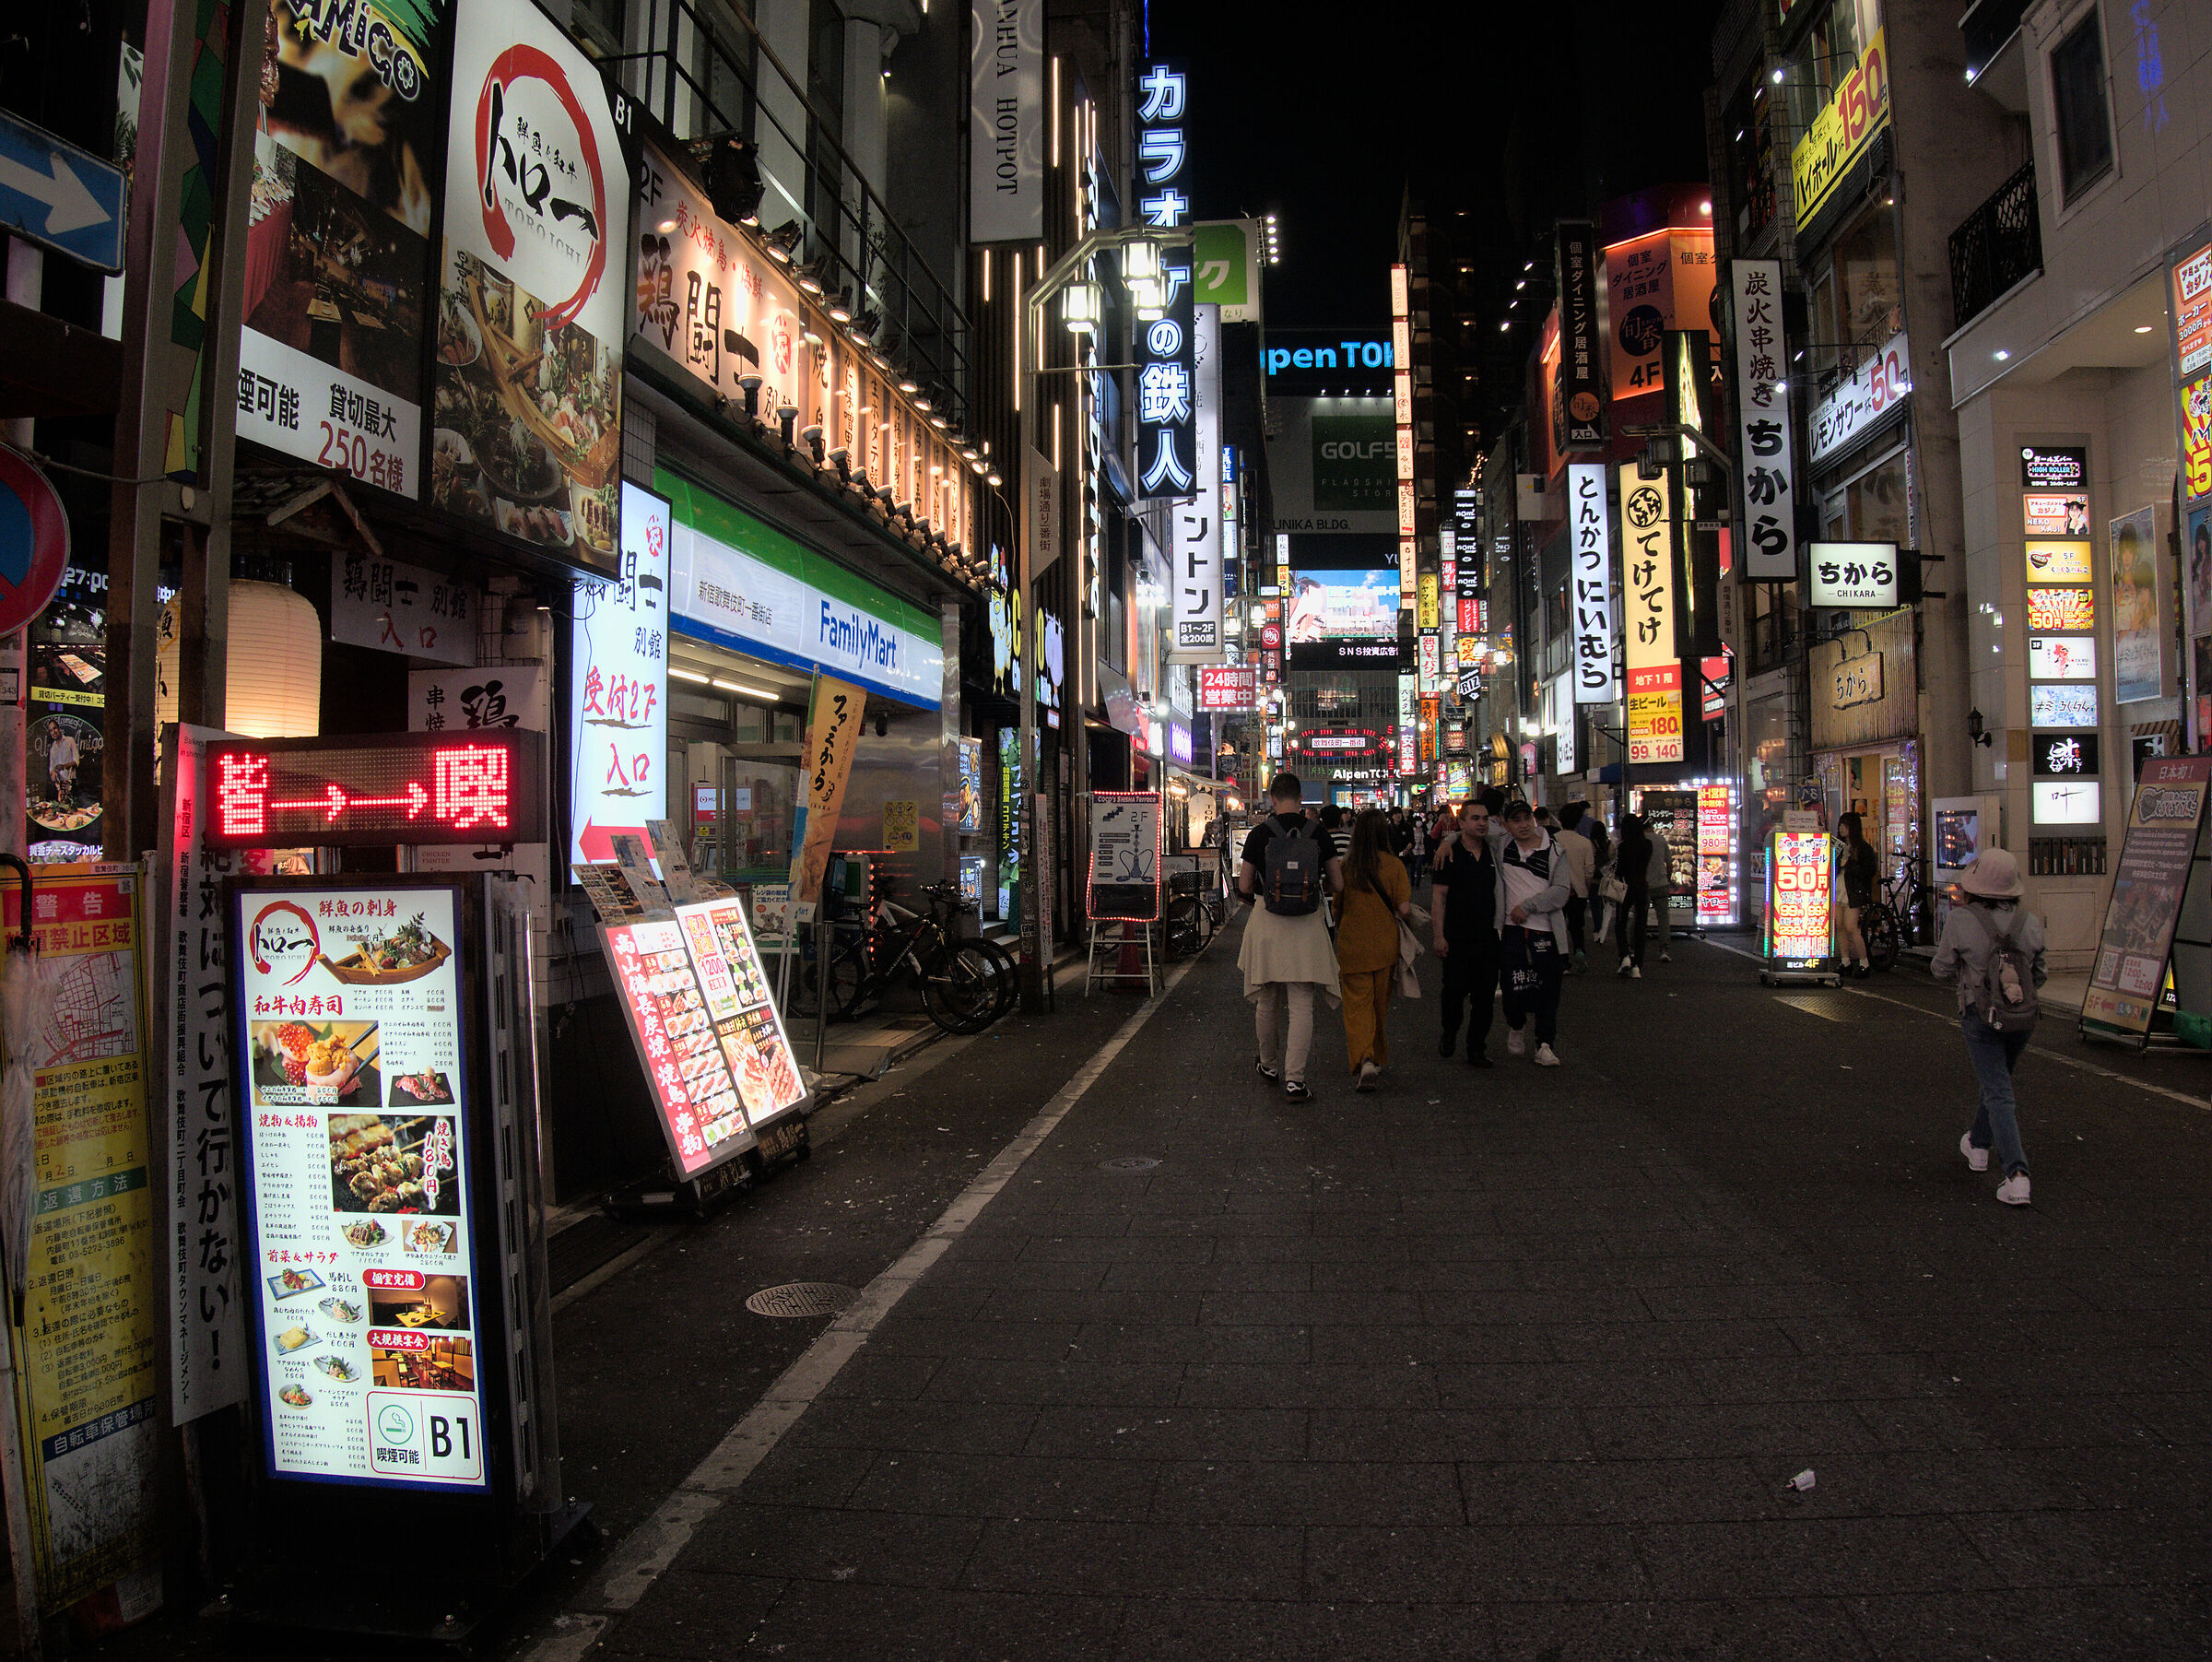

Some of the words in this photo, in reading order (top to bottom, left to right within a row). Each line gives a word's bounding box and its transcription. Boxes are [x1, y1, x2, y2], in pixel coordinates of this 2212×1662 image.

[615, 94, 632, 136] B1
[1796, 136, 1838, 213] ハイボール
[1838, 47, 1888, 152] 150円
[996, 96, 1018, 195] HOTPOT
[504, 196, 546, 245] TORO
[550, 231, 582, 266] ICHI
[1627, 250, 1653, 266] 個室
[1612, 260, 1669, 289] ダイニング
[1622, 279, 1661, 301] 居酒屋
[1568, 241, 1590, 380] 個室ダイニング居酒屋
[1744, 271, 1780, 407] 炭火串焼き
[1629, 360, 1661, 389] 4F
[330, 382, 397, 444] 貸切最大
[1574, 428, 1594, 440] 入口
[1810, 398, 1864, 458] レモンサワー
[318, 419, 404, 493] 250名様
[1747, 418, 1789, 556] ちから
[1039, 477, 1052, 551] 劇場通り一番街
[1273, 519, 1314, 530] UNIKA
[1316, 519, 1351, 531] BLDG.
[1578, 476, 1601, 572] とんかつ
[2027, 518, 2050, 526] NEKO
[2041, 525, 2061, 534] KAJI
[586, 550, 664, 612] 闘士
[1818, 560, 1894, 586] ちから
[1633, 531, 1665, 645] てけてけ
[1836, 589, 1877, 598] CHIKARA
[431, 584, 469, 619] 別館
[698, 581, 773, 628] 新宿歌舞伎町一番街店
[381, 611, 438, 651] 入口
[1577, 577, 1608, 690] にいむら
[2030, 611, 2063, 630] 50円
[633, 627, 663, 660] 別館
[819, 599, 897, 669] FamilyMart
[1180, 633, 1215, 643] 全200席
[1338, 647, 1399, 656] SNS投資広告
[1205, 672, 1253, 687] 24時間
[1635, 671, 1674, 687] 地下1階
[1835, 667, 1866, 701] ちから
[1205, 690, 1253, 705] 営業中
[1629, 696, 1667, 711] 生ビール
[1313, 738, 1364, 748] 歌舞伎町一番街
[1401, 735, 1414, 772] 安楽亭
[606, 743, 651, 787] 入口
[1333, 769, 1369, 781] Alpen
[2159, 763, 2195, 781] 日本初!
[1002, 805, 1010, 850] ココチキン
[1130, 811, 1148, 822] 2F
[29, 844, 104, 856] 黄金チーズタッカルビ
[1701, 838, 1727, 848] 980円
[1778, 854, 1829, 865] ハイボール
[1777, 865, 1829, 891] 50円
[35, 891, 104, 919] 警告
[318, 898, 397, 918] 鮮魚の刺身
[1804, 958, 1820, 969] 4F
[253, 996, 344, 1017] 和牛肉寿司
[2088, 994, 2101, 1010] 5F
[259, 1113, 318, 1128] 焼物&揚物
[436, 1119, 452, 1168] 焼き鳥
[43, 1173, 128, 1210] 返還方法
[267, 1249, 340, 1264] 前菜&サラダ
[328, 1272, 353, 1282] 馬刺し
[371, 1271, 416, 1287] 個室完備
[371, 1332, 425, 1348] 大規模宴会
[53, 1398, 156, 1455] 自転車保管場所
[429, 1415, 471, 1460] B1
[376, 1447, 420, 1465] 喫煙可能
